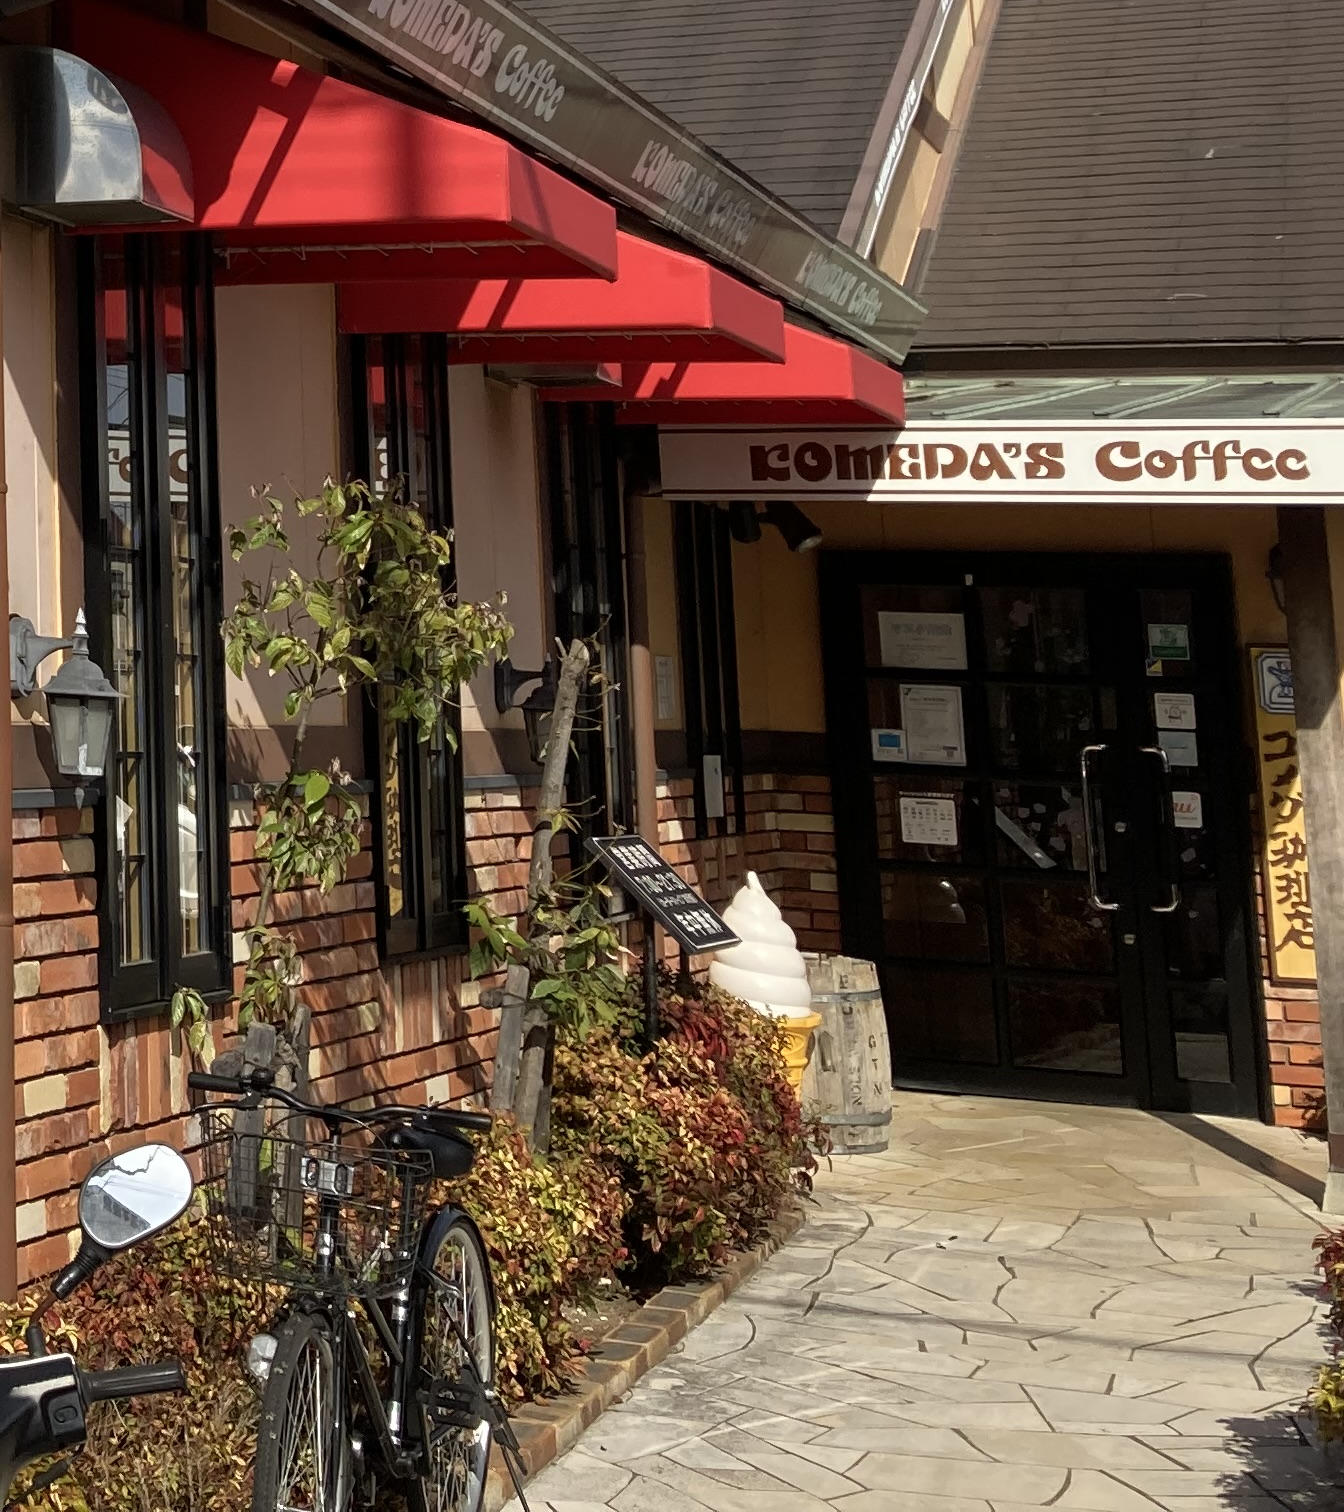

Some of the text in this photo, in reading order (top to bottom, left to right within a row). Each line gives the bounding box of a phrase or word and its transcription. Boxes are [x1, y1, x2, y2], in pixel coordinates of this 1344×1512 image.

[495, 43, 566, 124] Coffee
[749, 439, 1311, 482] KOMEDA'S Coffee
